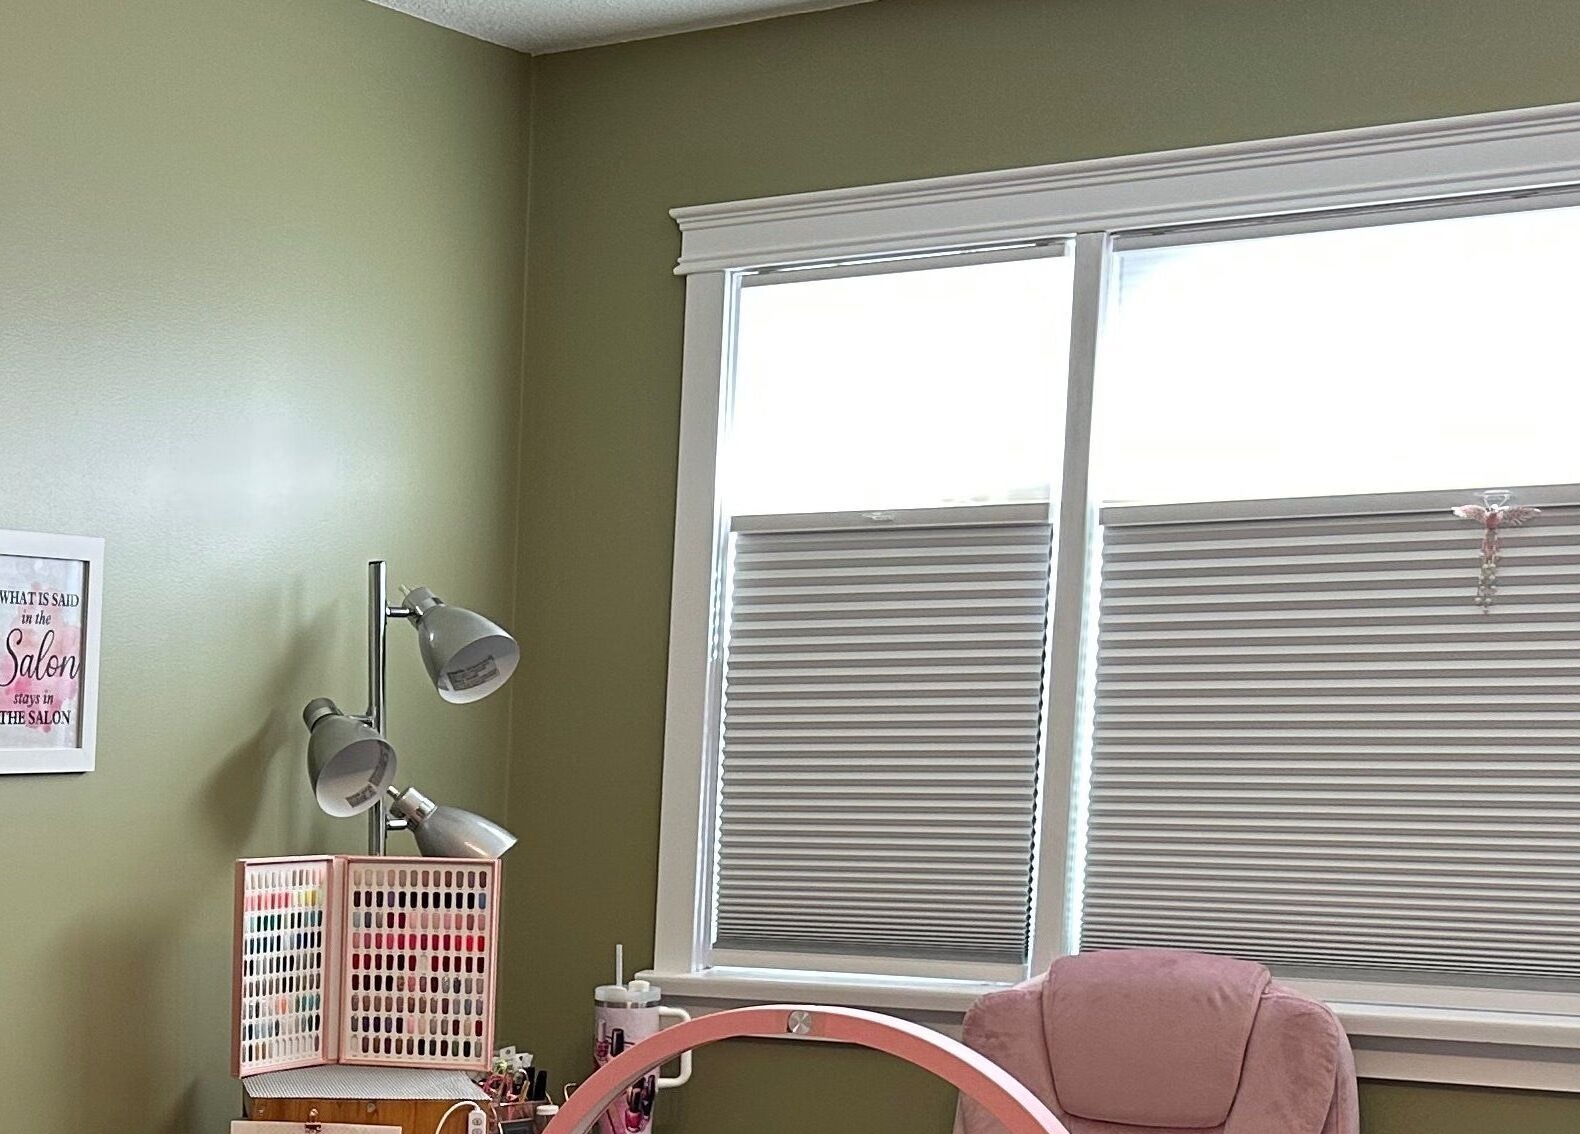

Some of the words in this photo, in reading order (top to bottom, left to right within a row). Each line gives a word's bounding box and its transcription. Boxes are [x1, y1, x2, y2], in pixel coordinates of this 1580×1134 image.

[38, 592, 50, 606] IS
[51, 592, 80, 608] SAID
[21, 610, 33, 625] in
[34, 611, 52, 626] the
[13, 691, 40, 708] stays
[43, 690, 54, 705] in
[28, 710, 72, 726] SALON
